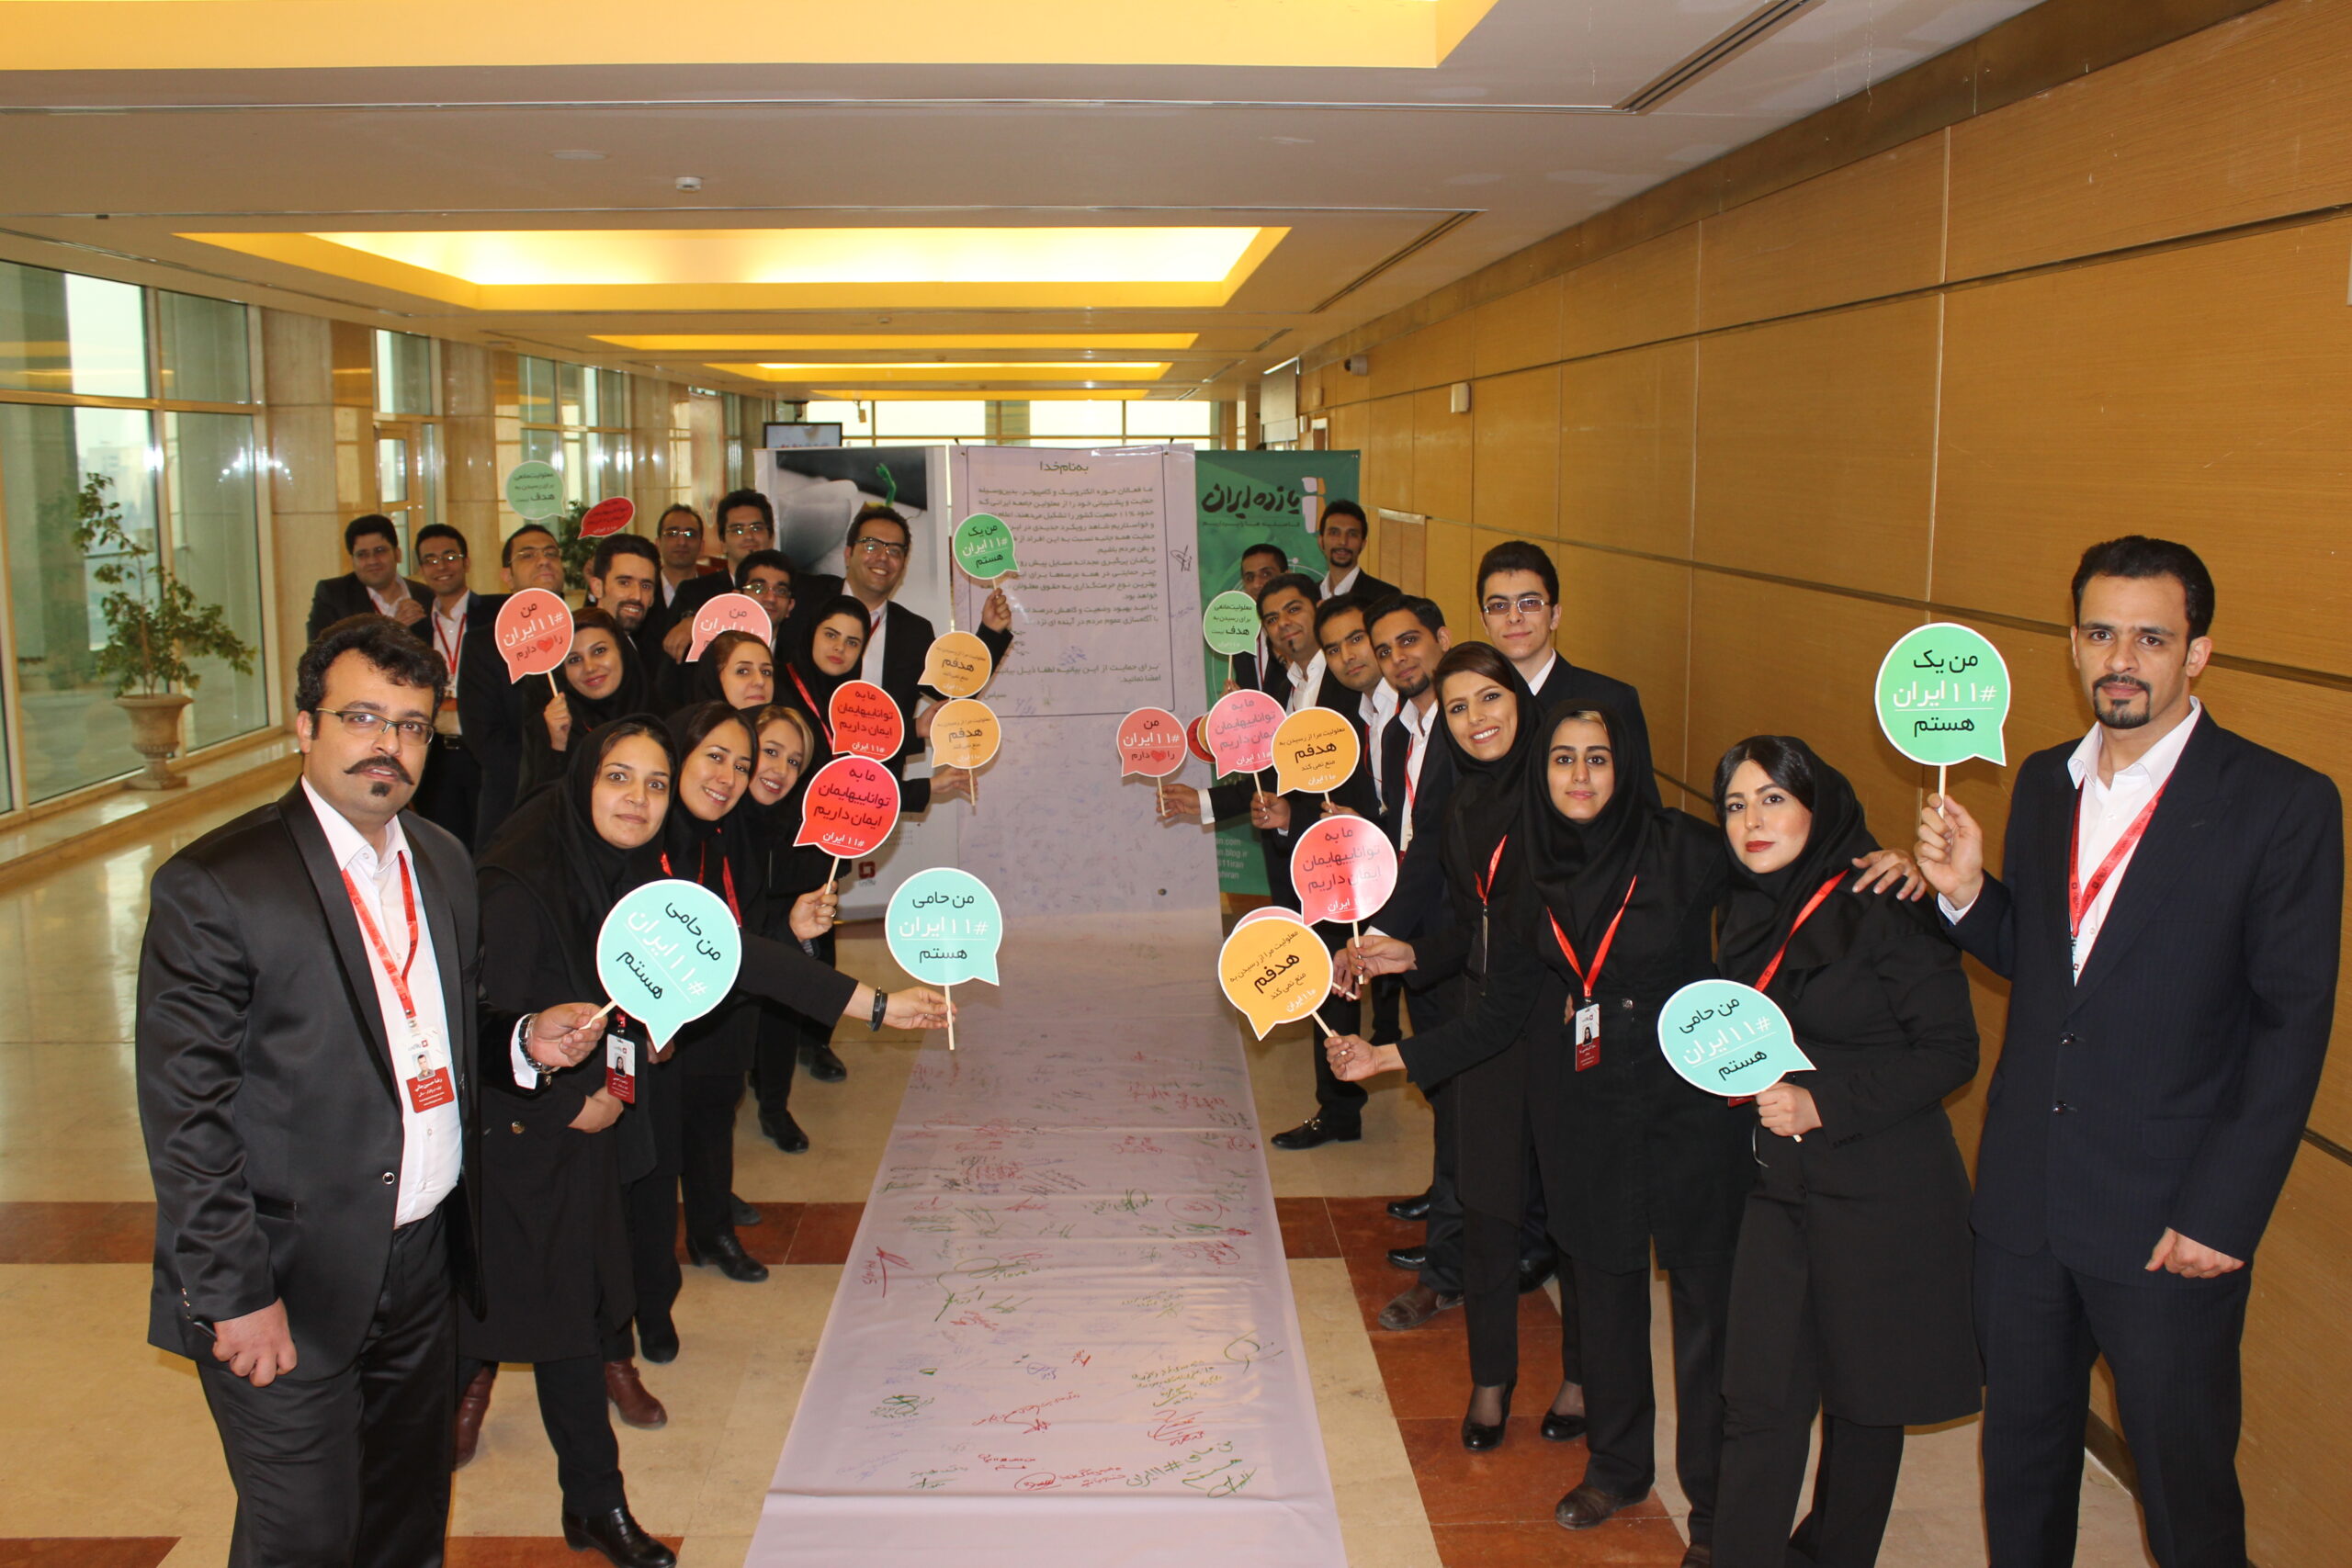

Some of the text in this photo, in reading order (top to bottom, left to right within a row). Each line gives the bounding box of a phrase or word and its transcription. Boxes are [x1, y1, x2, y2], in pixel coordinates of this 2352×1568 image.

[1201, 481, 1301, 520] یازده ایران
[967, 525, 998, 537] من یک
[975, 553, 1003, 569] هستم
[520, 603, 537, 617] من
[729, 607, 747, 619] من
[1226, 625, 1250, 636] هدف
[515, 634, 563, 660] را دارم
[941, 657, 974, 672] هدفم
[1913, 649, 1978, 673] من یک
[854, 690, 876, 701] ما به
[1231, 698, 1255, 712] ما به
[839, 720, 892, 739] ایمان داریم
[1143, 719, 1159, 730] من
[1913, 716, 1975, 738] هستم
[948, 727, 983, 742] هدفم
[1219, 734, 1250, 750] داریم
[1131, 750, 1175, 761] را دارم
[1294, 741, 1337, 763] هدفم
[1324, 759, 1335, 769] منع
[849, 768, 876, 782] ما به
[813, 805, 882, 829] ایمان داریم
[1324, 827, 1353, 843] ما به
[1307, 873, 1346, 894] داریم
[912, 890, 975, 908] من حامی
[665, 901, 721, 961] من حامی
[1274, 931, 1298, 950] معلولیت
[919, 947, 967, 964] هستم
[1263, 948, 1274, 958] مرا
[616, 951, 663, 999] هستم
[1238, 960, 1260, 978] رسیدن
[1253, 953, 1300, 994] هدفم
[1229, 976, 1238, 984] به
[1295, 972, 1306, 986] منع
[1679, 998, 1740, 1033] من حامی
[1718, 1050, 1768, 1081] هستم
